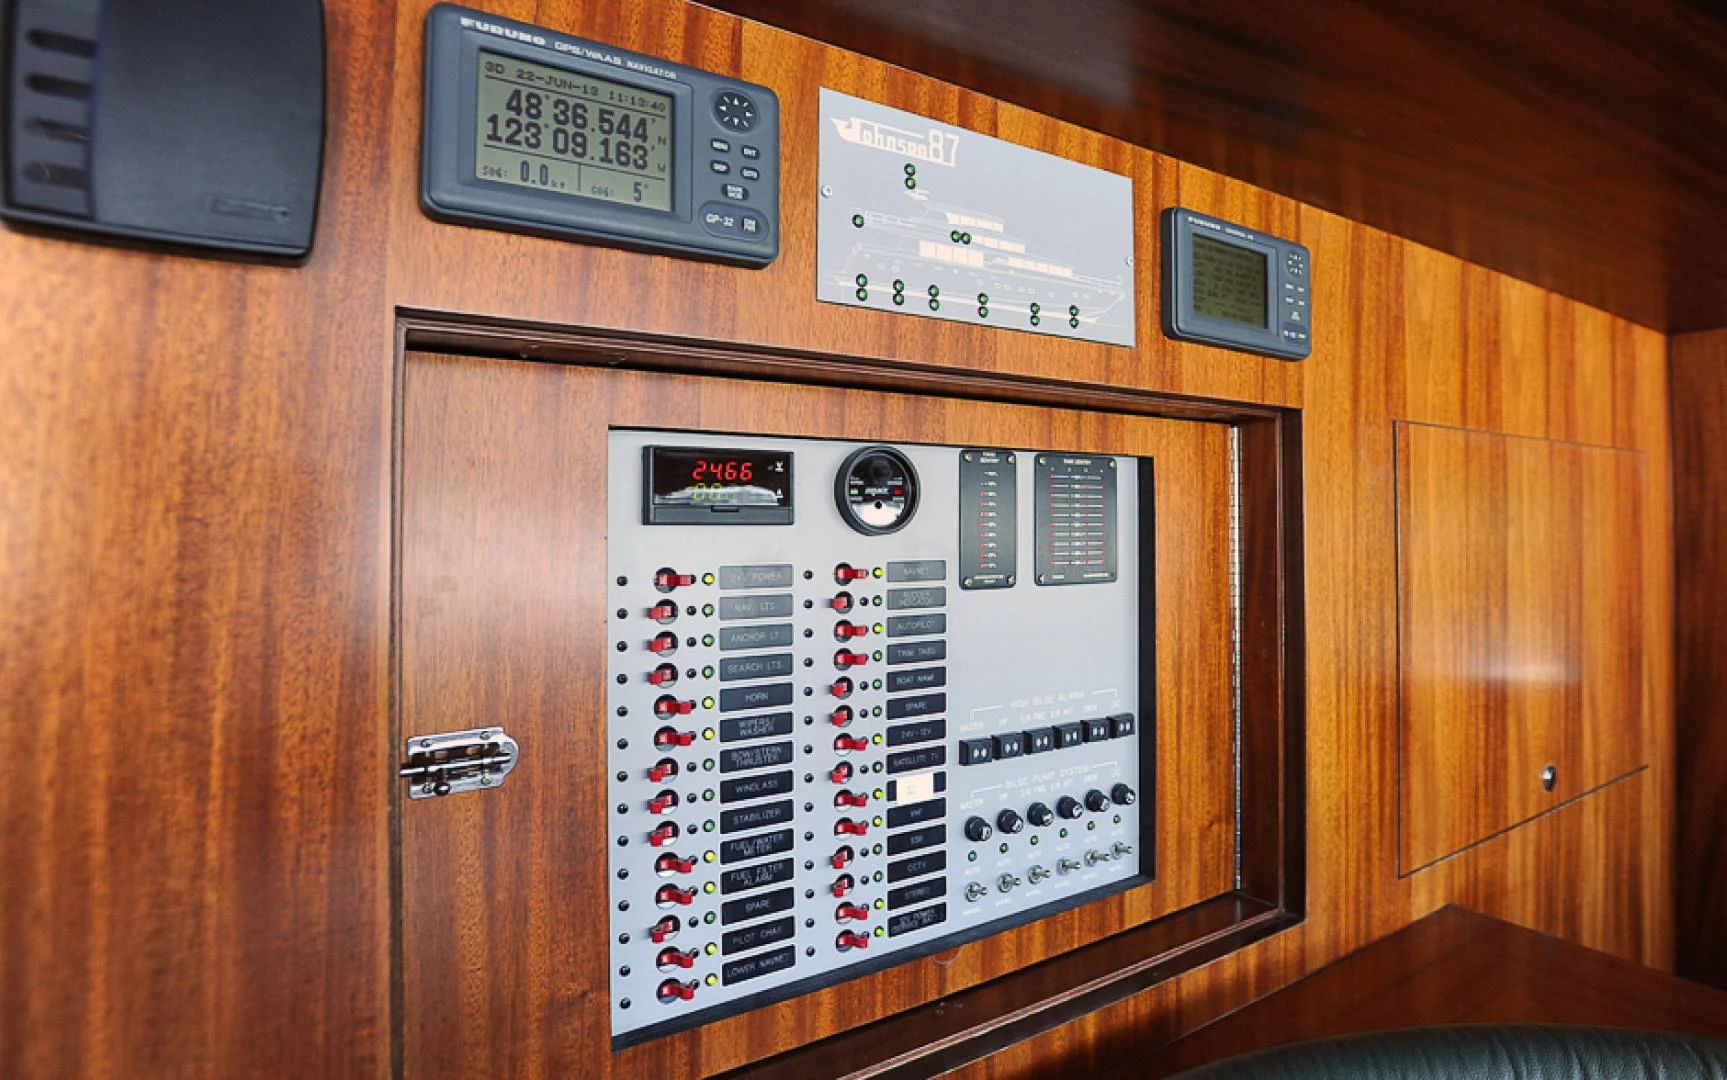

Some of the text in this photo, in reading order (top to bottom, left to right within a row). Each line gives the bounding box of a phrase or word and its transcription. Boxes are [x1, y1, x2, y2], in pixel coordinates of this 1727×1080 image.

[461, 16, 547, 47] FURUNO
[626, 59, 677, 80] NAVIGATOR
[519, 160, 549, 186] 0.0
[705, 212, 734, 227] GP-32
[760, 602, 776, 611] LTS
[896, 619, 936, 631] AUTOPILOT
[730, 632, 765, 643] ANCHOR
[727, 660, 782, 674] SEARCH LTS
[744, 691, 769, 704] HORN
[735, 779, 778, 793] WINDLASS
[732, 807, 782, 826] STABILIZER
[731, 862, 784, 882] FUEL FILTER
[745, 898, 772, 913] SPARE
[732, 932, 756, 945] PILOT
[727, 962, 756, 978] LOWER
